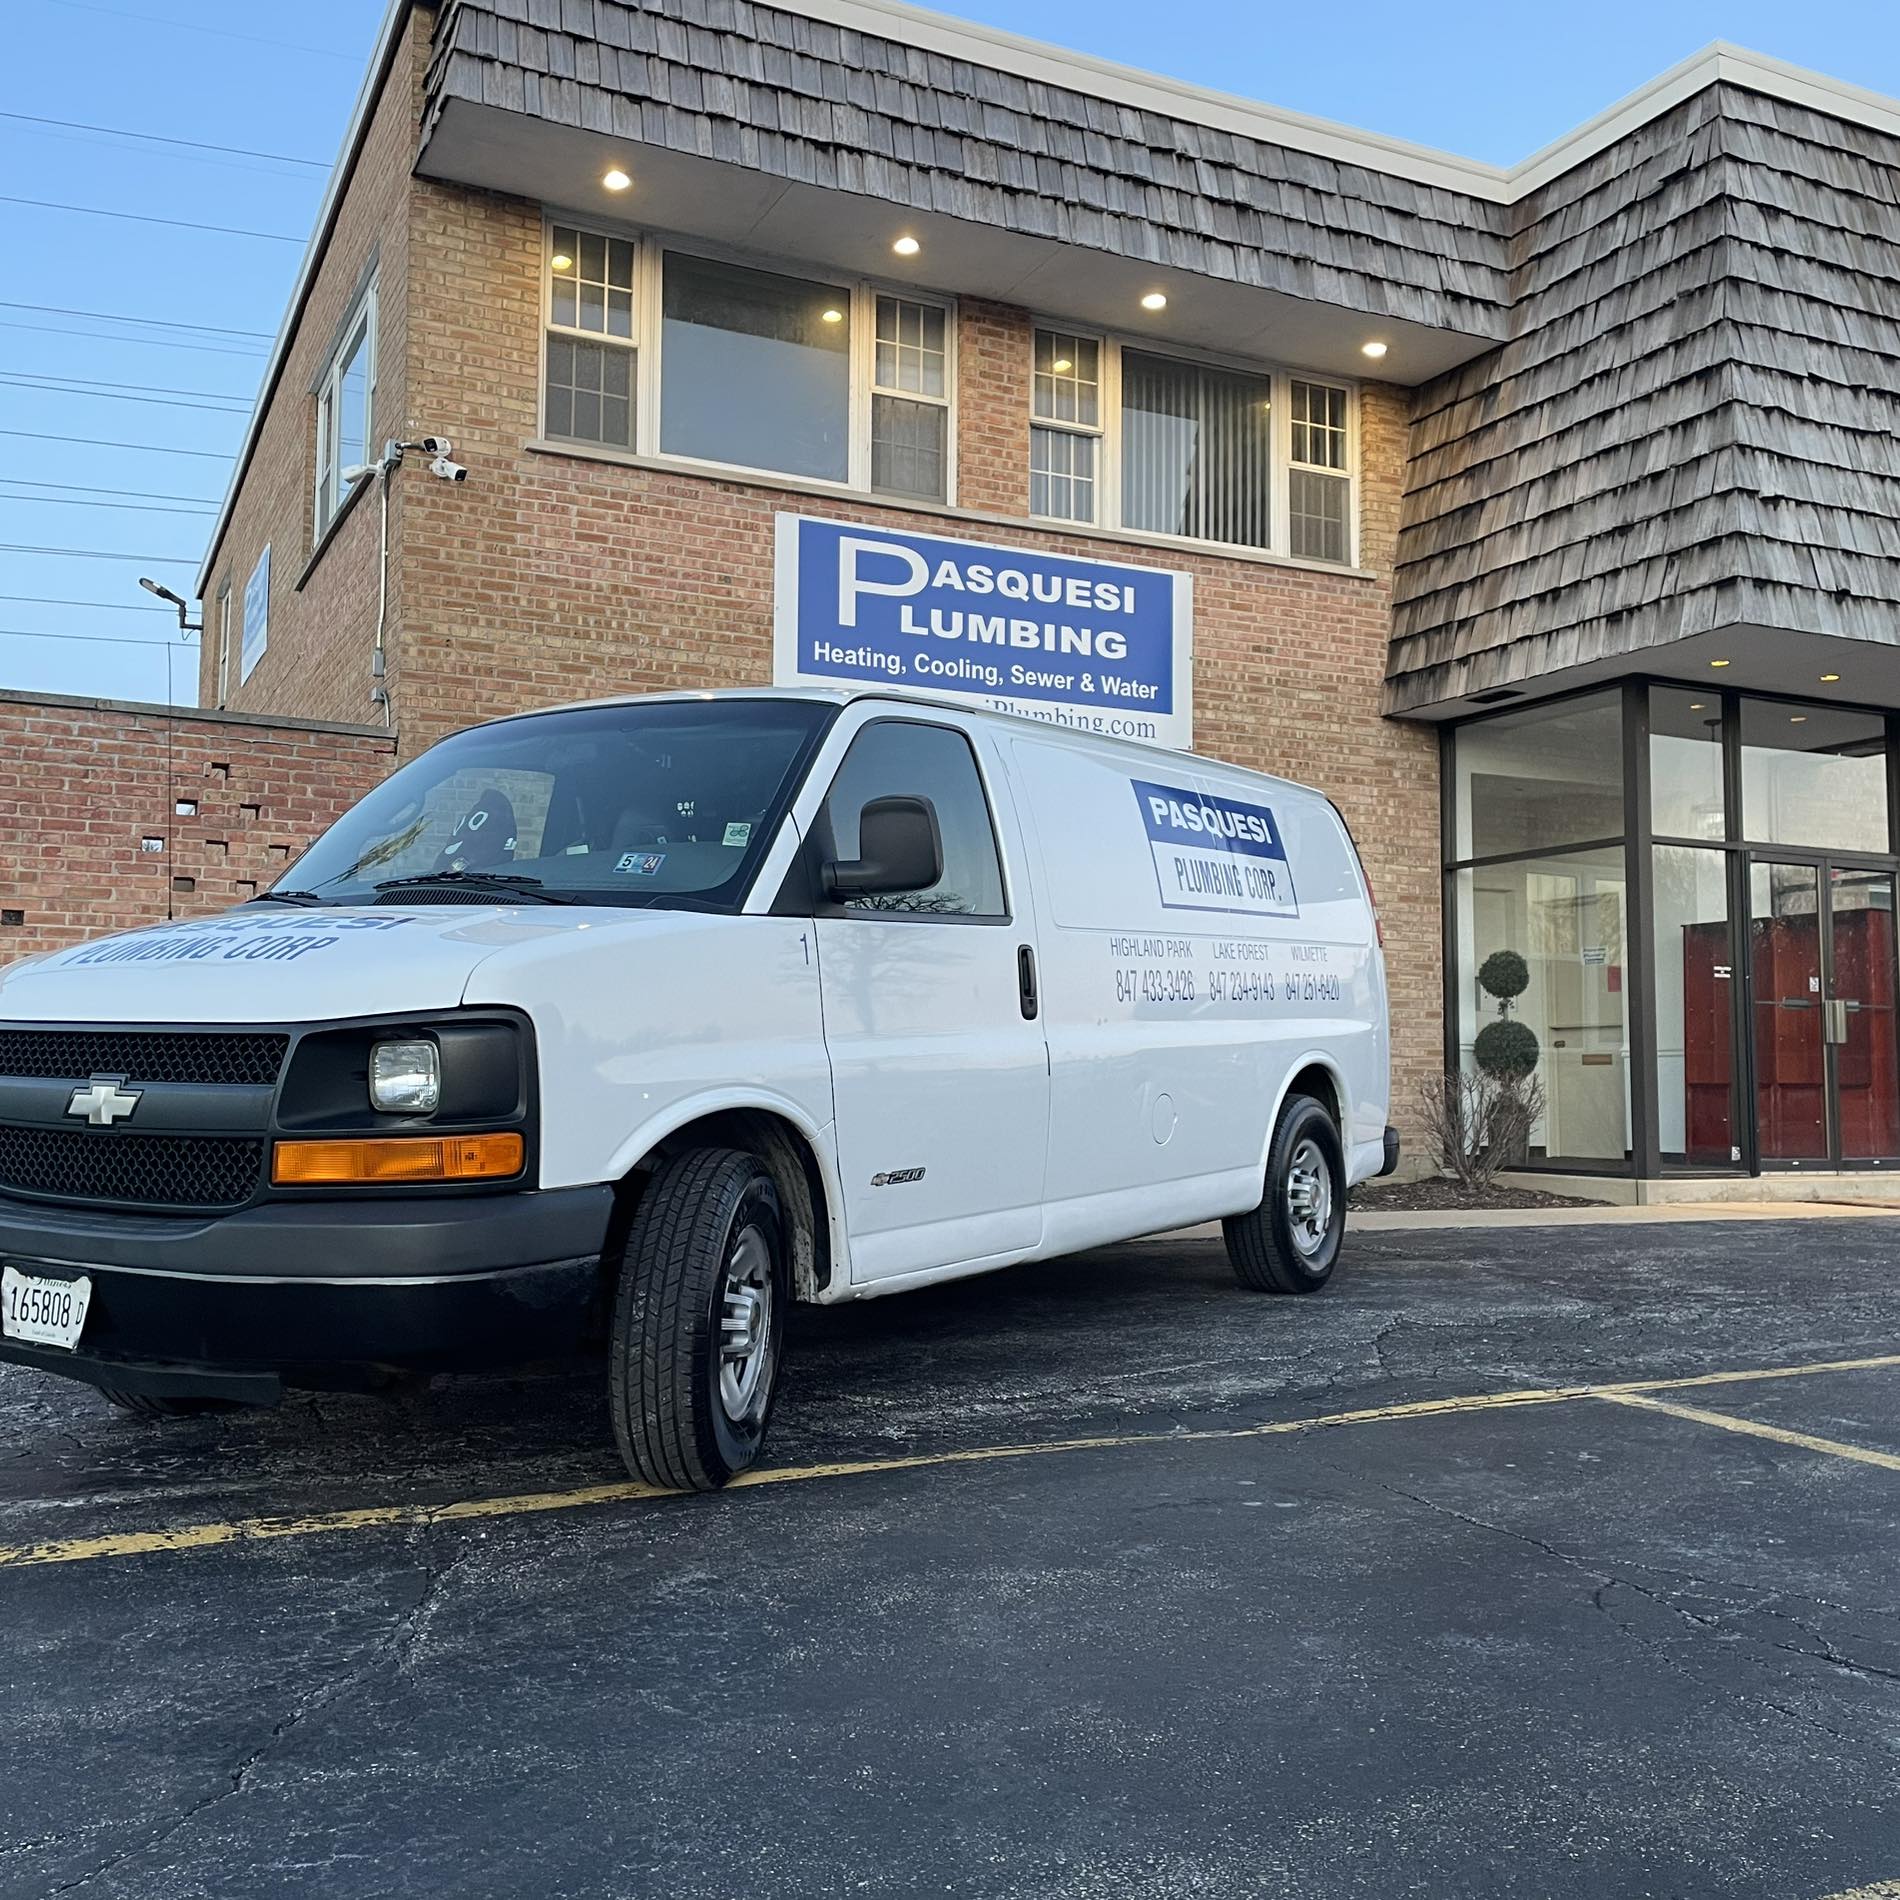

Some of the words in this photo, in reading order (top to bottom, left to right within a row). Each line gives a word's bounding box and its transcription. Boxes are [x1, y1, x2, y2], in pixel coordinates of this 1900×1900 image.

[813, 641, 907, 675] Heating,
[914, 653, 1004, 687] Cooling,
[1011, 665, 1075, 691] Sewer
[1080, 672, 1096, 693] &
[1100, 675, 1159, 700] Water
[1148, 796, 1273, 845] PASQUESI
[622, 855, 635, 867] 5
[643, 856, 659, 869] 24
[1174, 857, 1243, 897] PLUMBING
[60, 937, 239, 966] PLUMBING
[222, 935, 341, 961] CORP
[799, 933, 809, 965] 1
[1110, 937, 1165, 958] HIGHLAND
[1167, 940, 1194, 959] PARK
[1213, 943, 1237, 960] LAKE
[1238, 943, 1270, 961] FOREST
[1116, 969, 1137, 1002] 847
[1142, 969, 1196, 1002] 433-3426
[1208, 971, 1228, 1001] 847
[1230, 971, 1275, 1001] 234-9143
[1285, 972, 1300, 1001] 847
[889, 1169, 925, 1184] 2500
[11, 1286, 72, 1328] 165808
[75, 1302, 84, 1325] D
